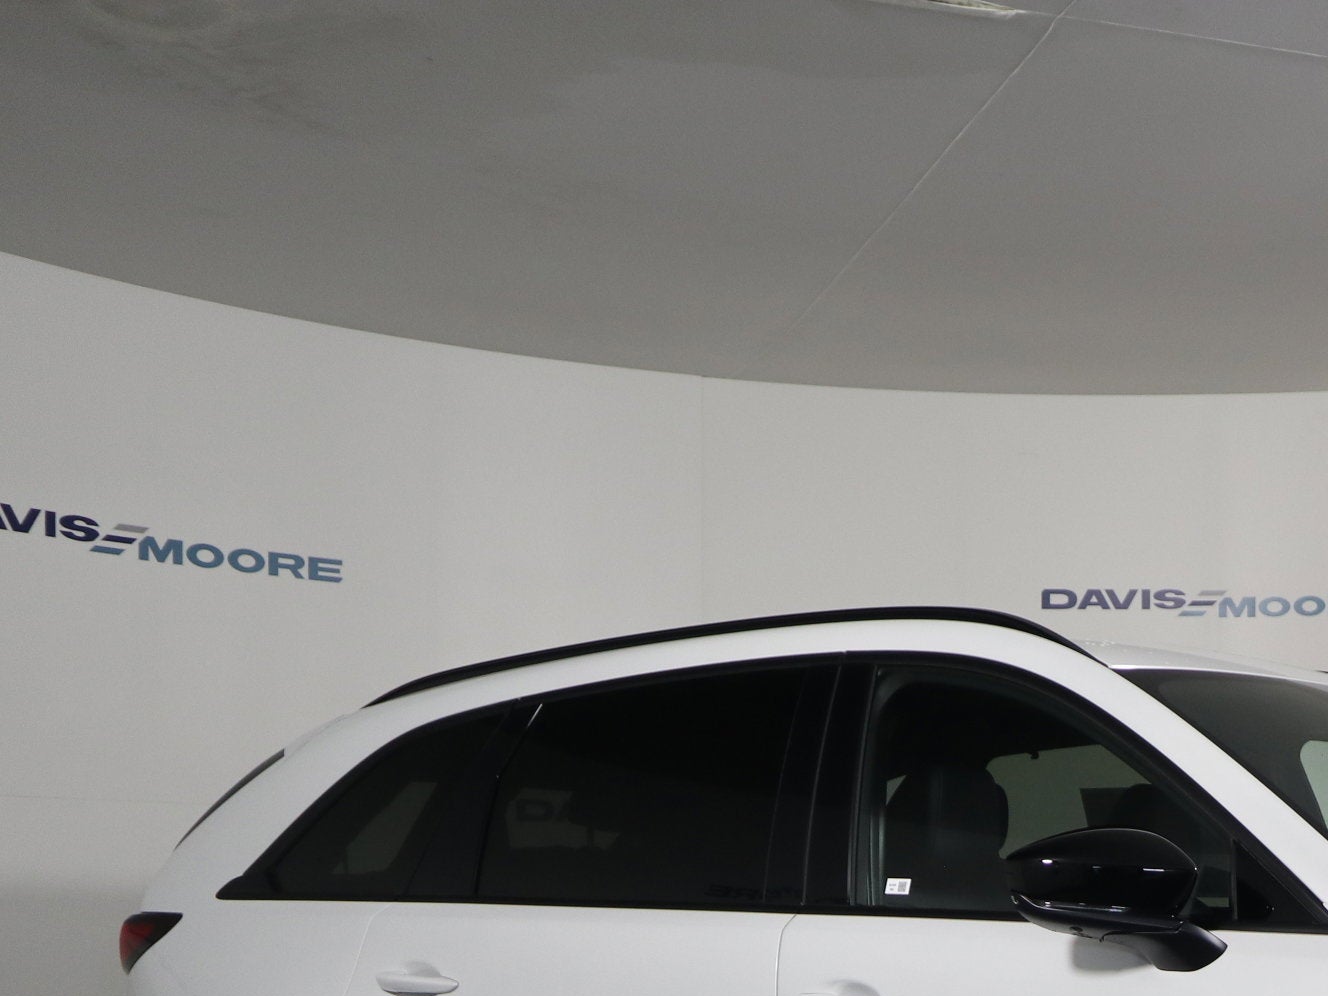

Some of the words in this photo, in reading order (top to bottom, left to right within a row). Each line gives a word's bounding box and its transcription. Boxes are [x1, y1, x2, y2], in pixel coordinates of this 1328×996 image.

[0, 504, 100, 542] VIS
[138, 535, 344, 583] MOORE
[1041, 588, 1187, 610] DAVIS
